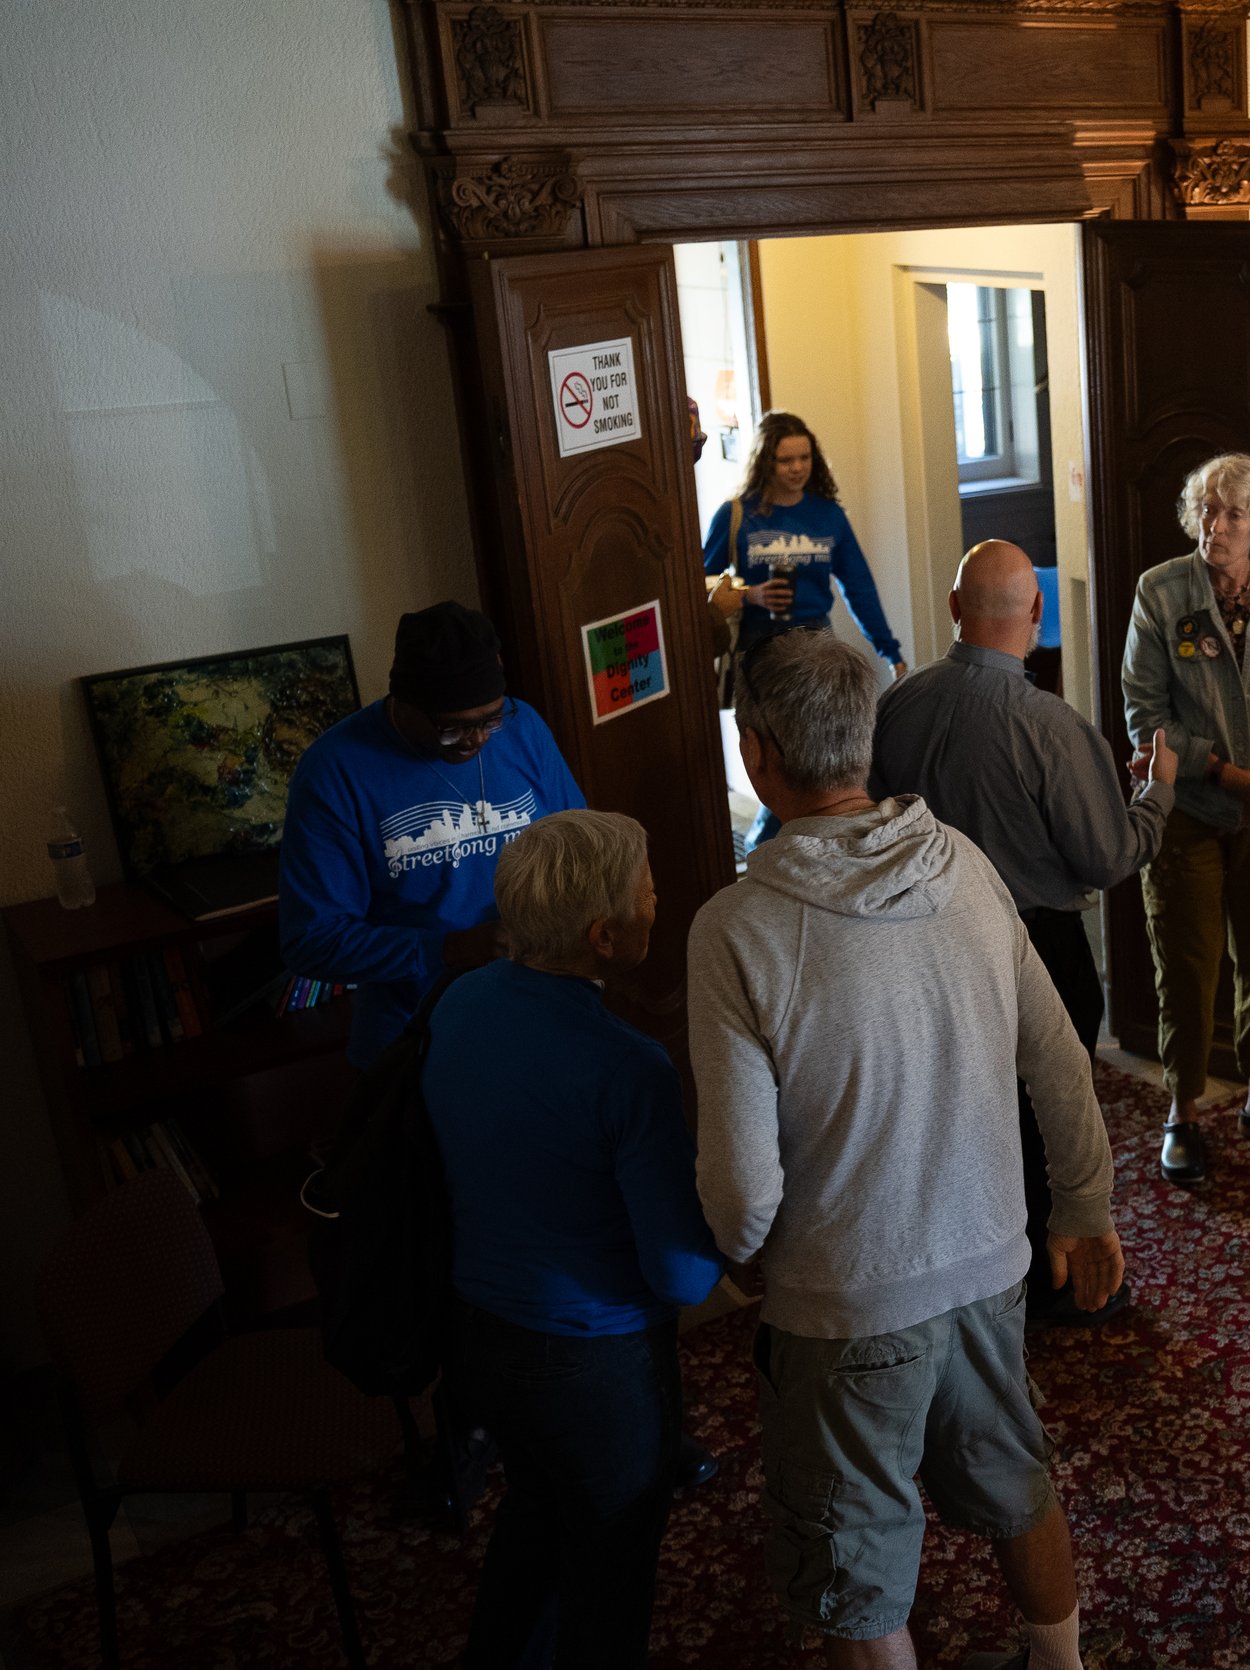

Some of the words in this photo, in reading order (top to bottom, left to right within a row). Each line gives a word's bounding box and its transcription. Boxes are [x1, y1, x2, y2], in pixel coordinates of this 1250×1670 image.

[592, 353, 621, 370] THANK
[590, 376, 608, 392] YOU
[610, 372, 627, 388] FOR
[602, 394, 620, 411] NOT
[593, 413, 633, 434] SMOKING
[595, 614, 650, 642] Welcome
[607, 653, 649, 679] Dignity
[610, 676, 652, 702] Center
